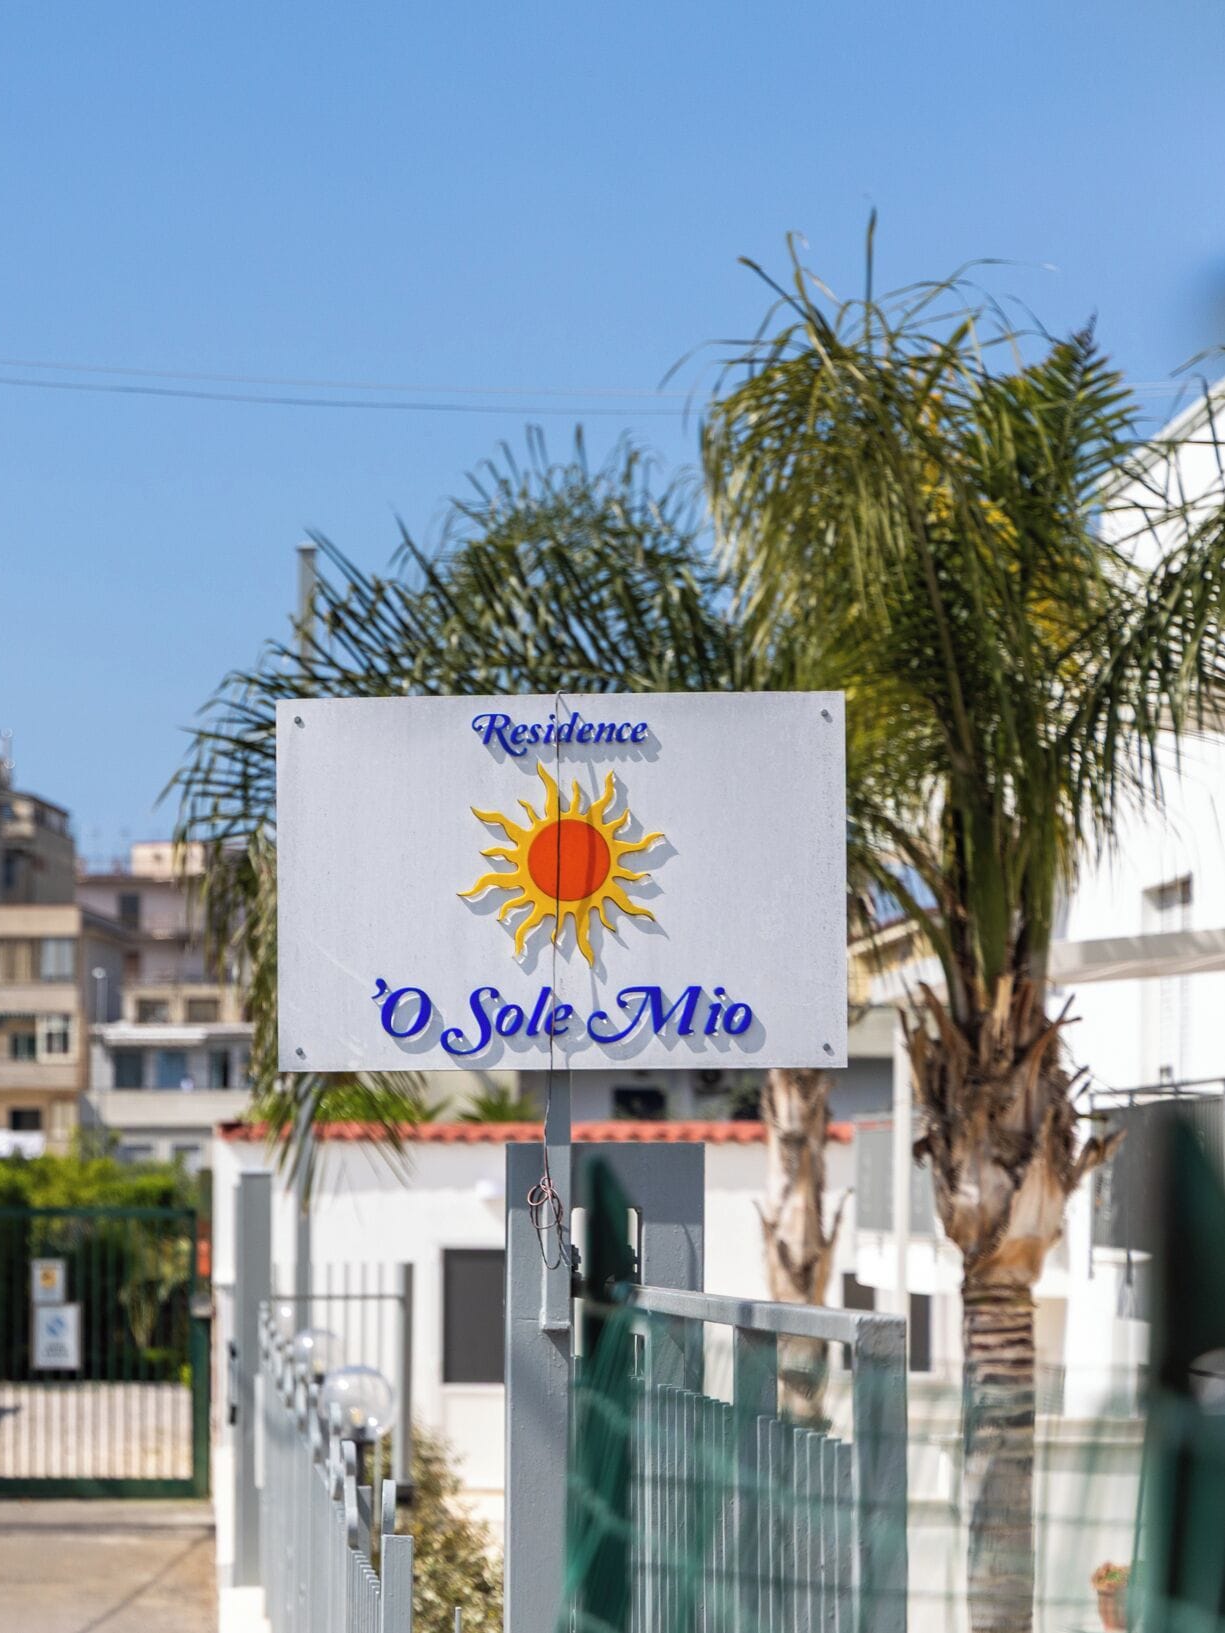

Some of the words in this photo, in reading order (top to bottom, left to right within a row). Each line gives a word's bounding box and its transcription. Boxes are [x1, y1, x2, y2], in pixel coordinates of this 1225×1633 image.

[471, 712, 648, 757] Residence
[440, 985, 573, 1056] Sole
[586, 984, 754, 1044] Mio
